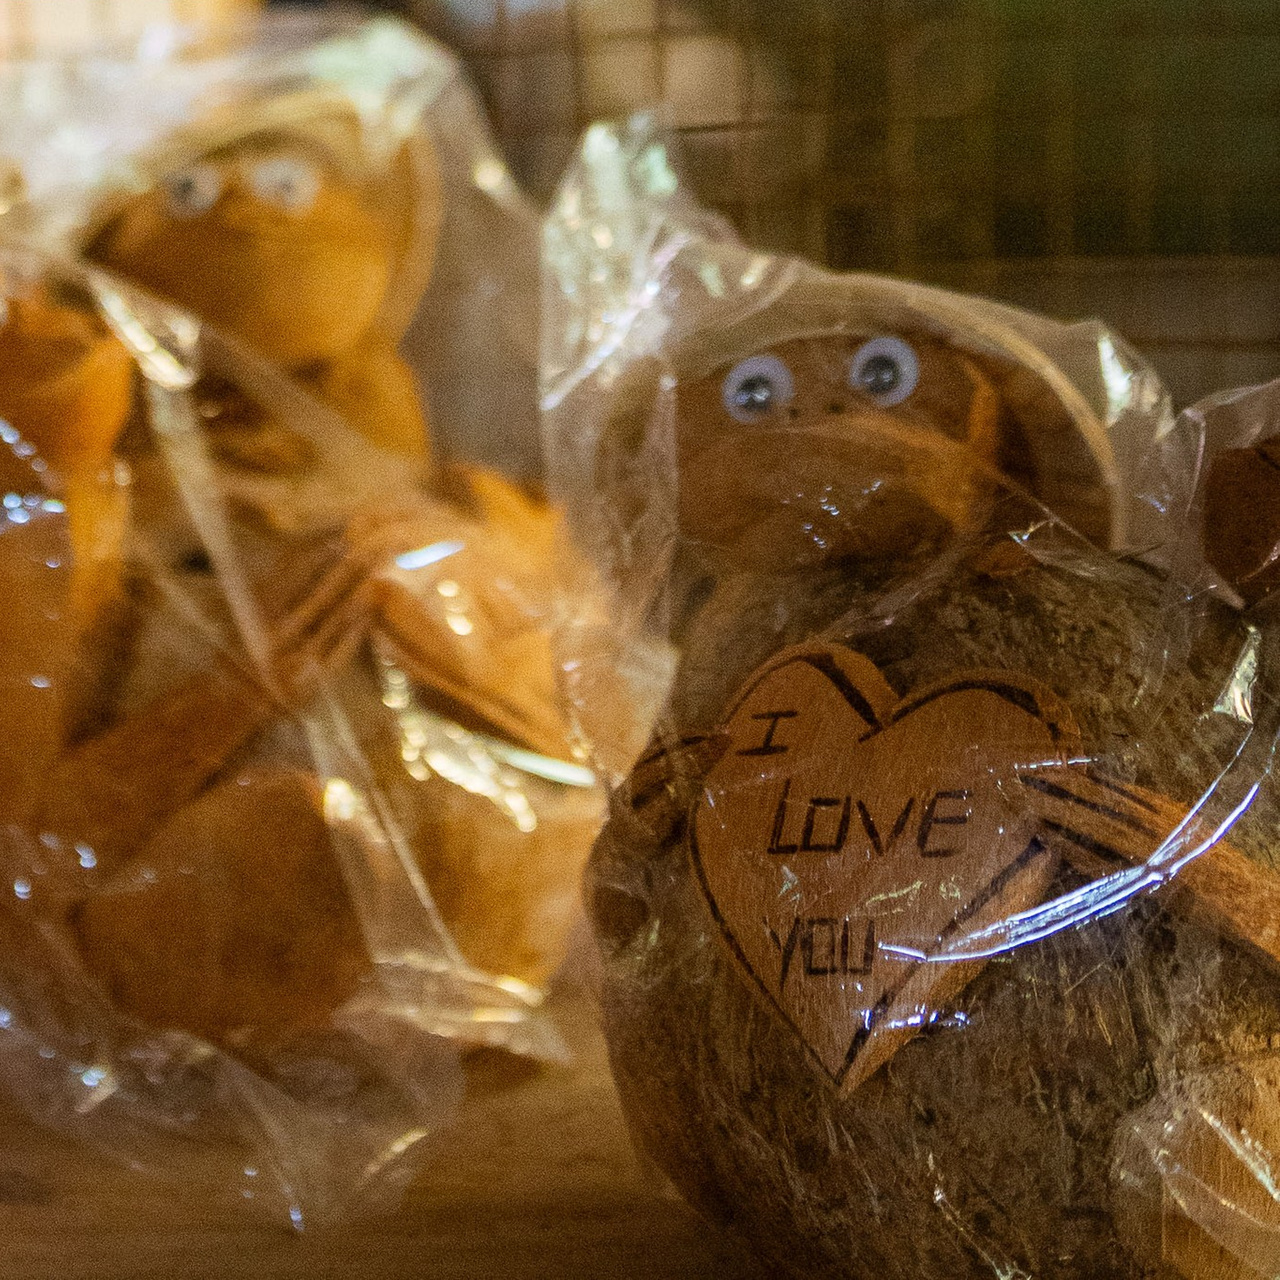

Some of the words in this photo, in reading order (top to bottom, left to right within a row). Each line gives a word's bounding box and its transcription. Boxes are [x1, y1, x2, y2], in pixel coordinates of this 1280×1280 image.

[737, 710, 798, 756] I
[767, 778, 974, 858] LOVE
[762, 915, 876, 993] YOU
